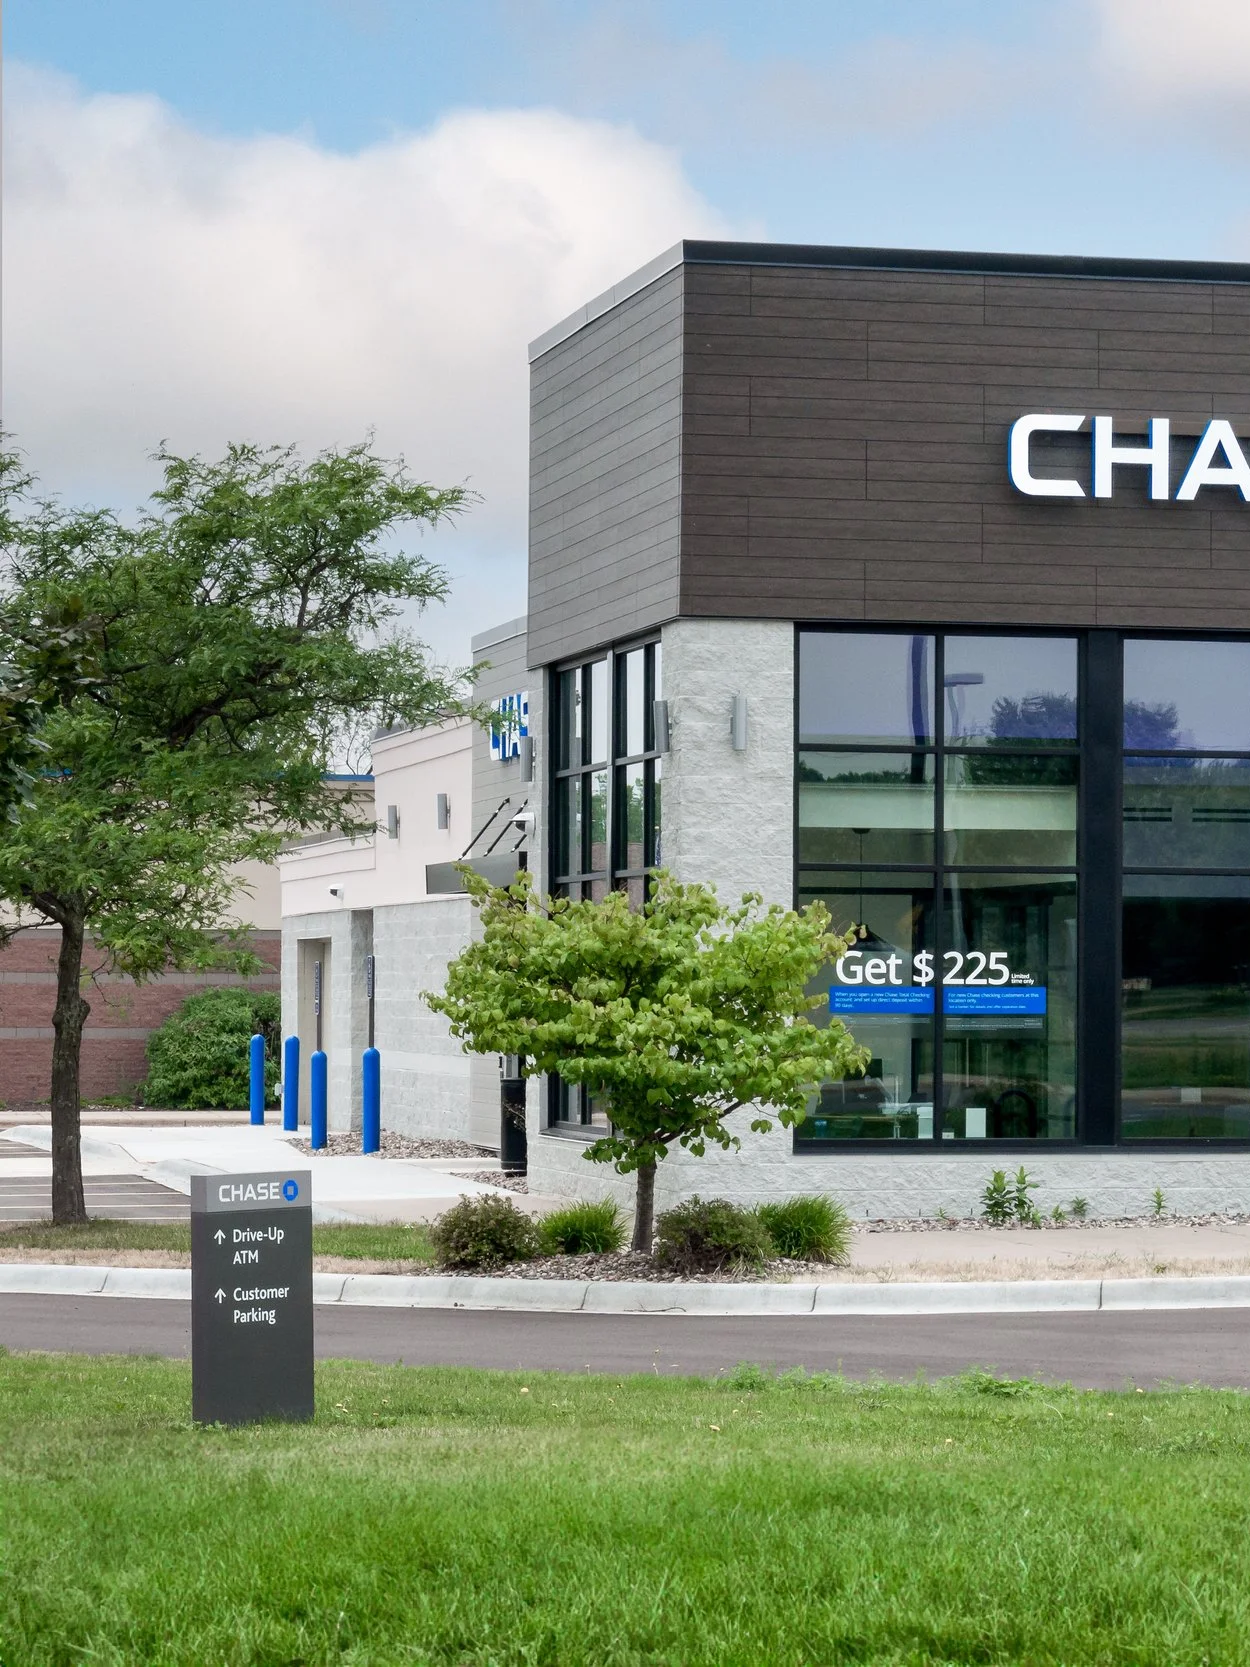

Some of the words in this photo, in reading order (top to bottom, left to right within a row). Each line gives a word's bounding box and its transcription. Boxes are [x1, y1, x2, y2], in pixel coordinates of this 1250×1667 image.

[836, 951, 902, 985] Get
[943, 951, 1010, 985] 225
[218, 1182, 280, 1203] CHASE
[232, 1227, 285, 1246] Drive-Up
[232, 1250, 259, 1265] ATM
[233, 1285, 290, 1302] Customer
[233, 1307, 276, 1325] Parking
